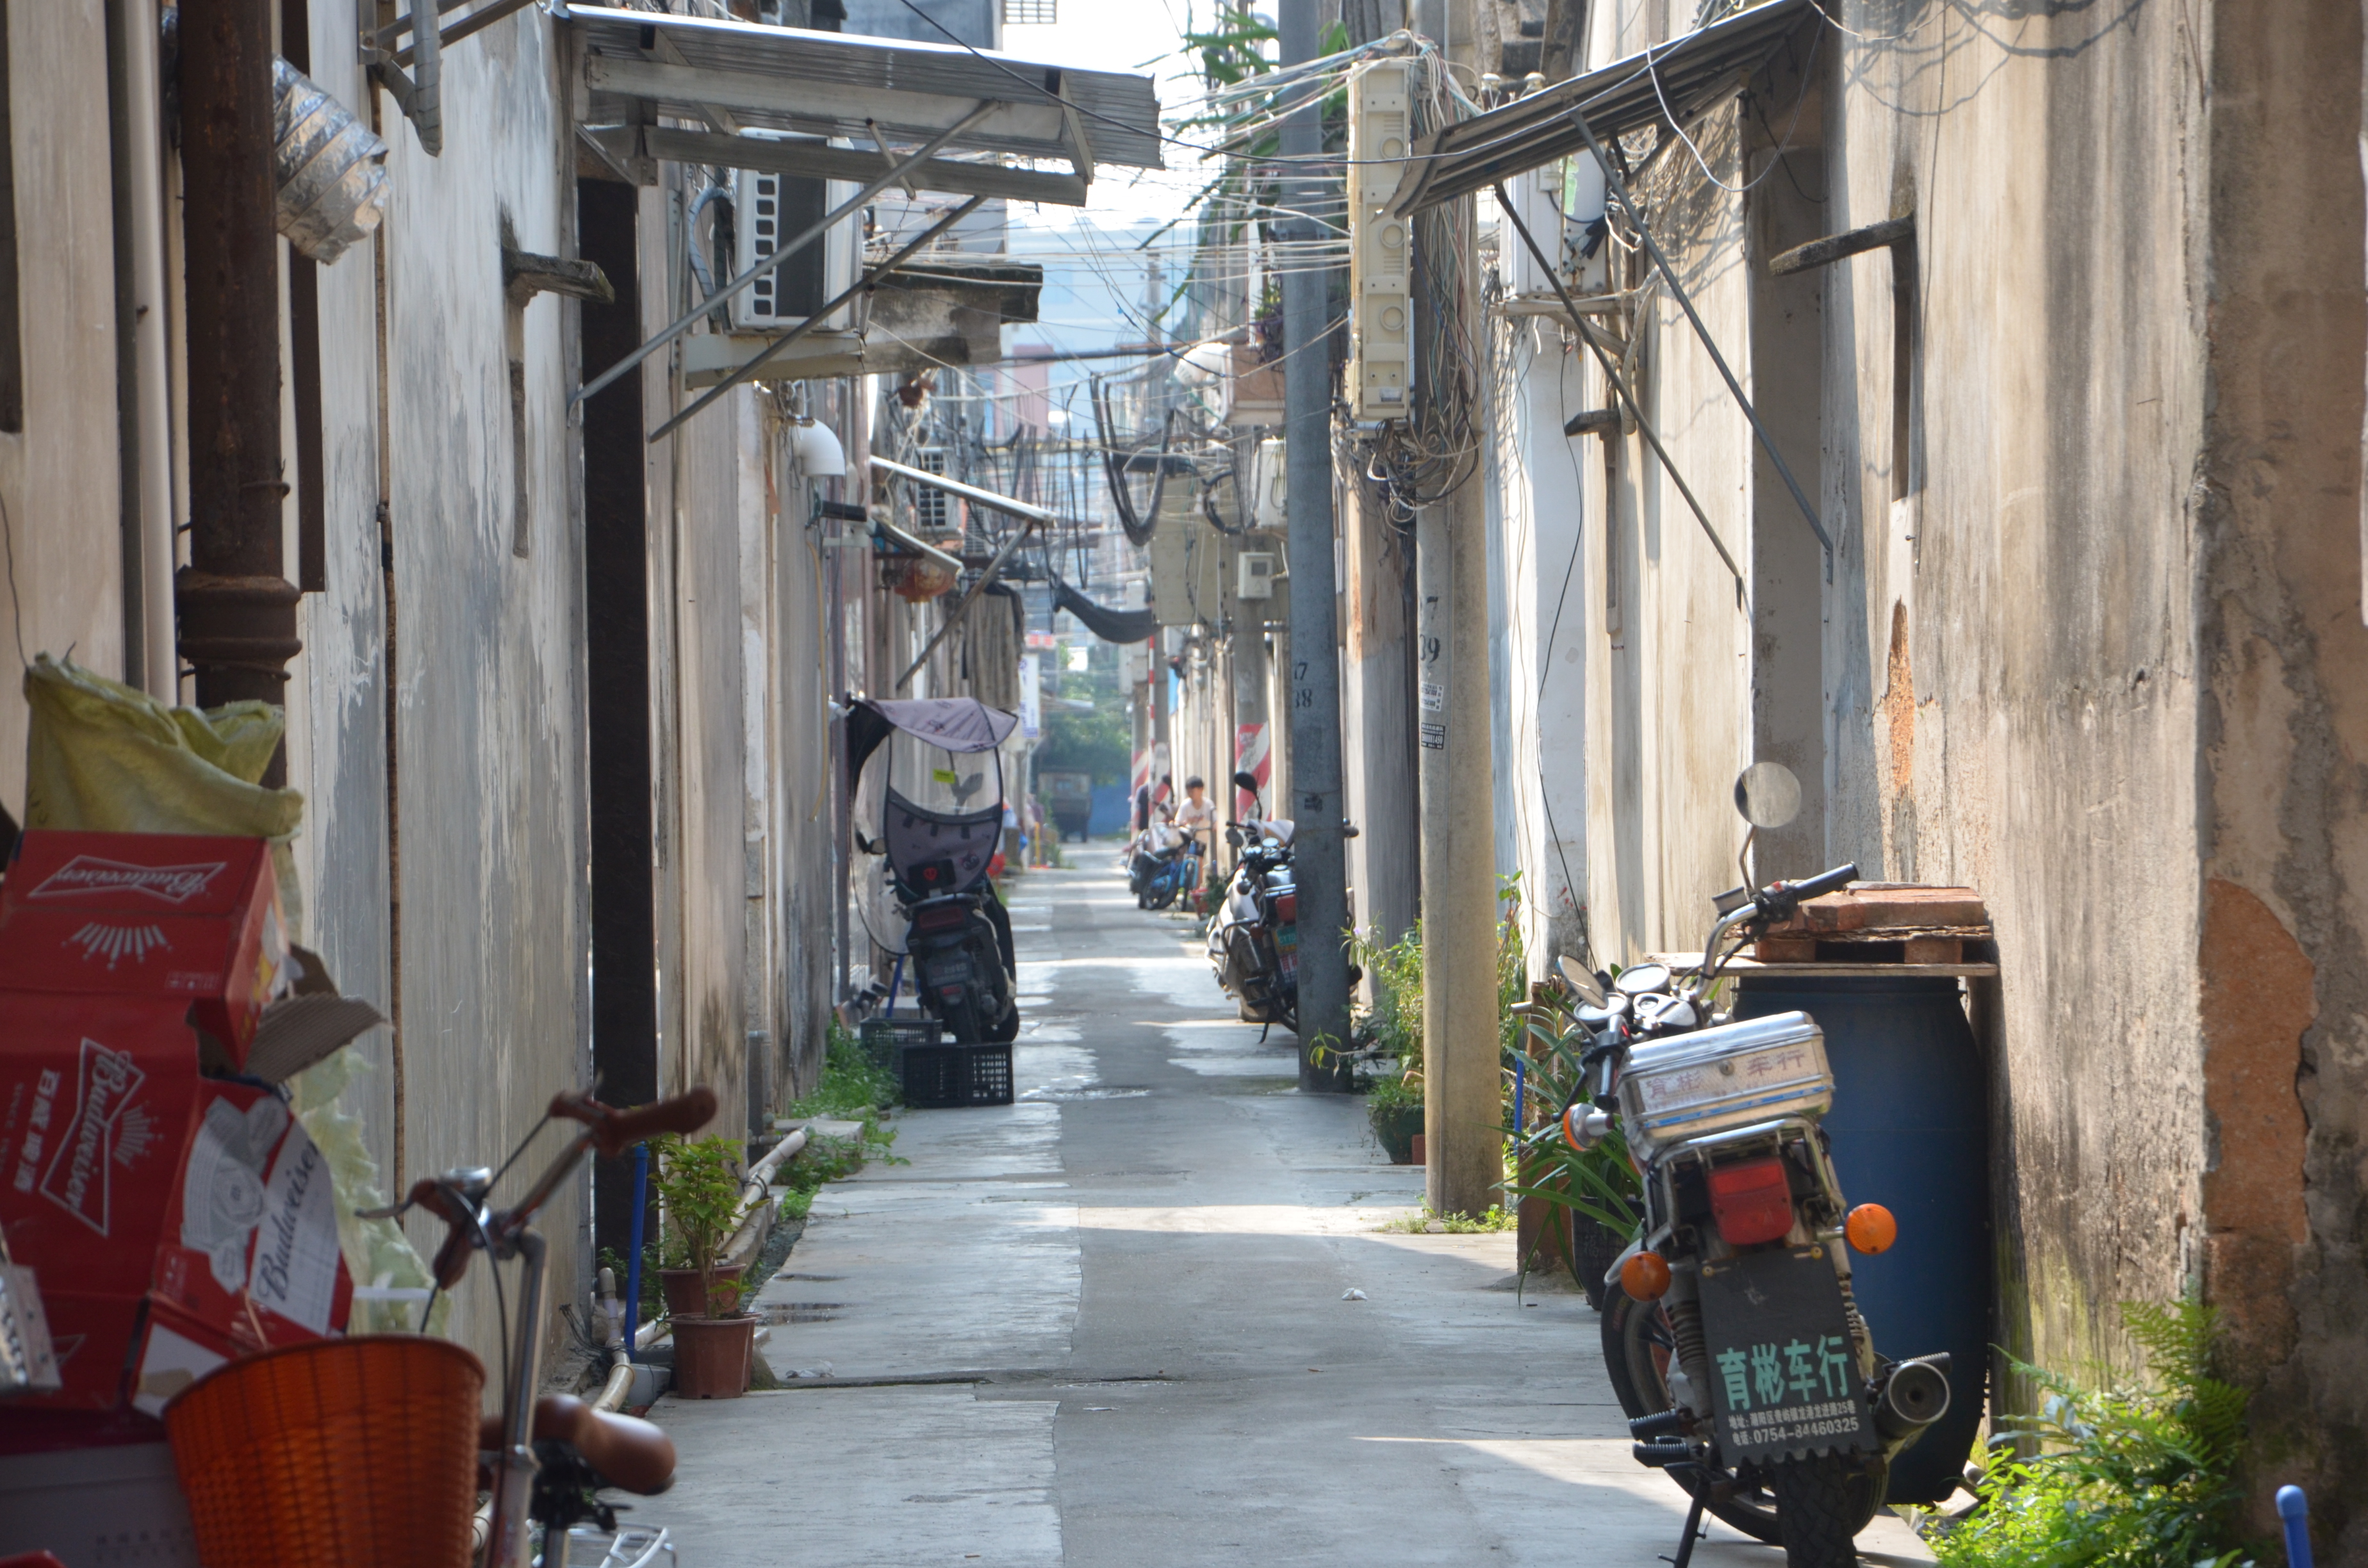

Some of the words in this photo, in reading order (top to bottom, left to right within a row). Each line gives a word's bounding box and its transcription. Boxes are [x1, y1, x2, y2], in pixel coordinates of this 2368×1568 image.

[55, 869, 206, 894] Budweiser
[65, 1050, 132, 1210] Budweiser
[257, 1139, 319, 1301] Budweiser
[1716, 1334, 1848, 1410] 育彬车行
